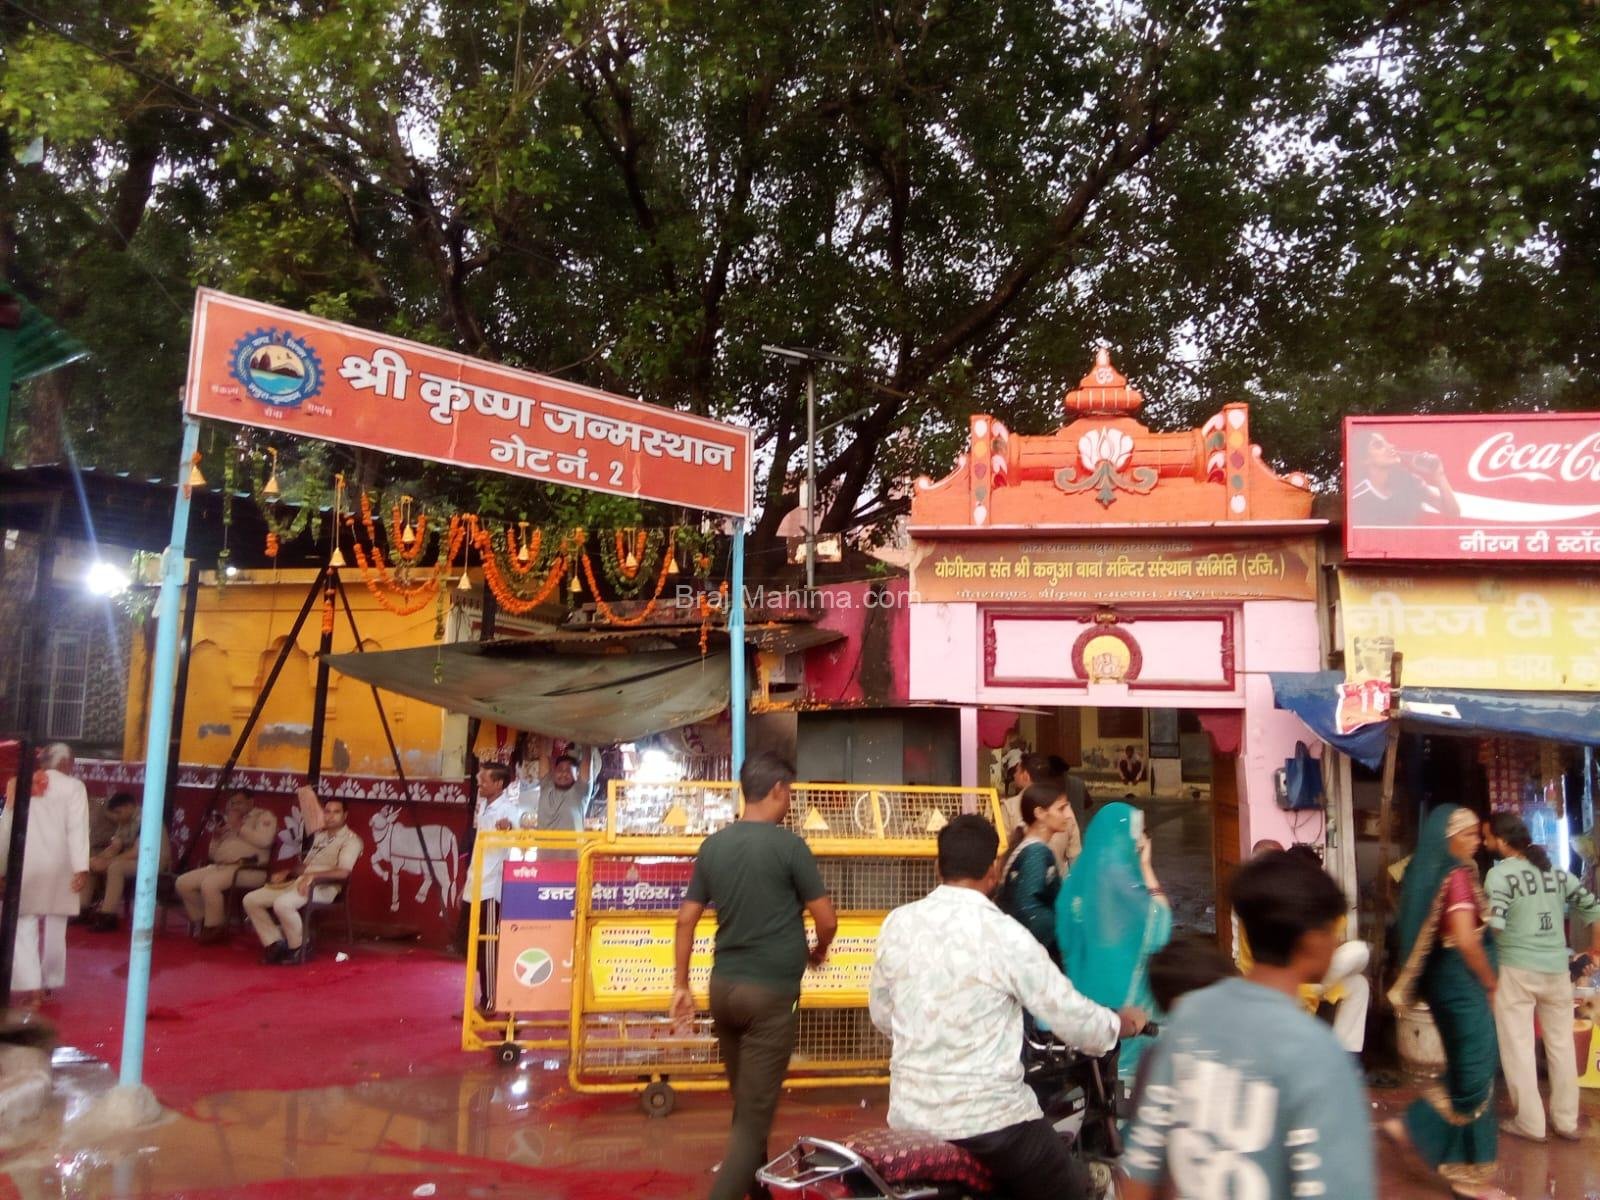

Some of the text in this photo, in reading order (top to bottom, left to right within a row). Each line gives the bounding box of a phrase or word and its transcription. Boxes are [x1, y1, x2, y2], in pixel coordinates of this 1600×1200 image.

[337, 347, 413, 401] श्री
[418, 369, 535, 428] कृष्ण
[540, 397, 736, 472] जन्मस्थान
[489, 434, 552, 473] गेट
[607, 459, 625, 487] 2
[1458, 530, 1520, 553] नीरज
[1524, 530, 1550, 553] टी
[934, 552, 1286, 586] योगीराज संत श्री कनुआ बाबा मन्दिर संस्थान समिति (रजि.)
[1503, 592, 1553, 637] टी
[537, 885, 575, 901] उत्तर
[591, 883, 618, 900] देश
